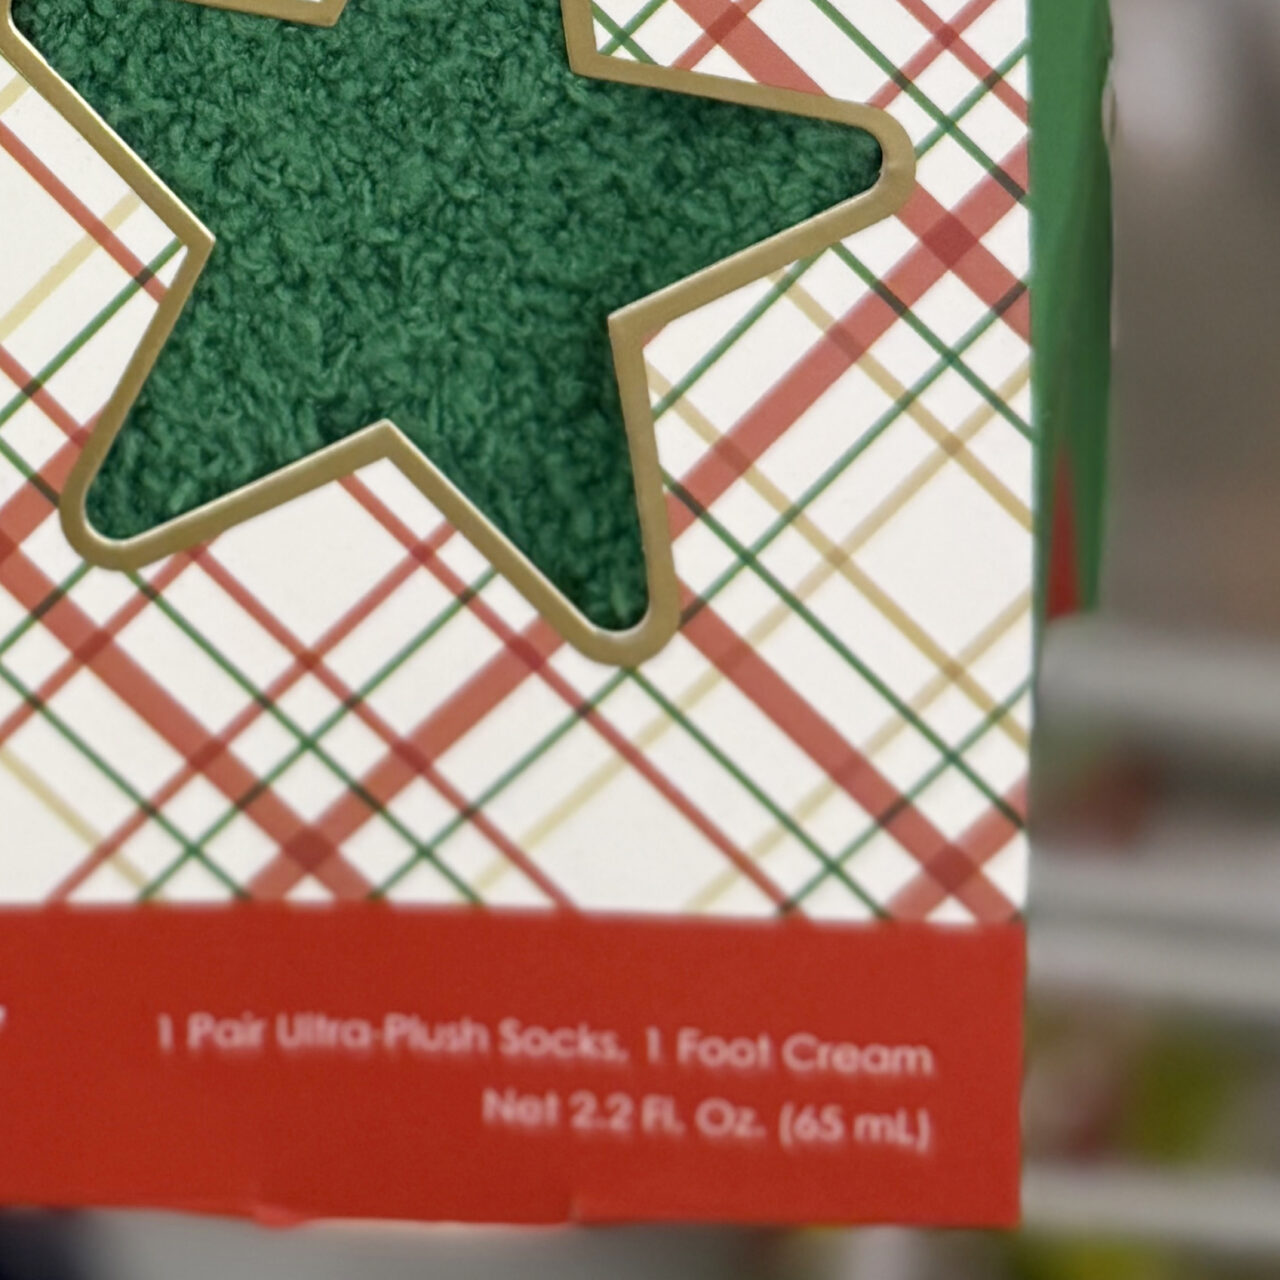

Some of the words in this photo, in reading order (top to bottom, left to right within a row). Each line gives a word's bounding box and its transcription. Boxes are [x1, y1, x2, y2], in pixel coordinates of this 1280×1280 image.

[156, 1014, 173, 1052] 1
[187, 1012, 267, 1051] Pair
[276, 1012, 490, 1056] Ultra-Plush
[644, 1026, 663, 1064] 1
[678, 1027, 773, 1071] Foot
[782, 1033, 934, 1076] Cream
[481, 1088, 561, 1127] Net
[569, 1091, 635, 1133] 2.2
[641, 1095, 687, 1136] Fl.
[695, 1098, 767, 1139] Oz.
[778, 1101, 846, 1148] (65
[854, 1105, 933, 1153] mL)
